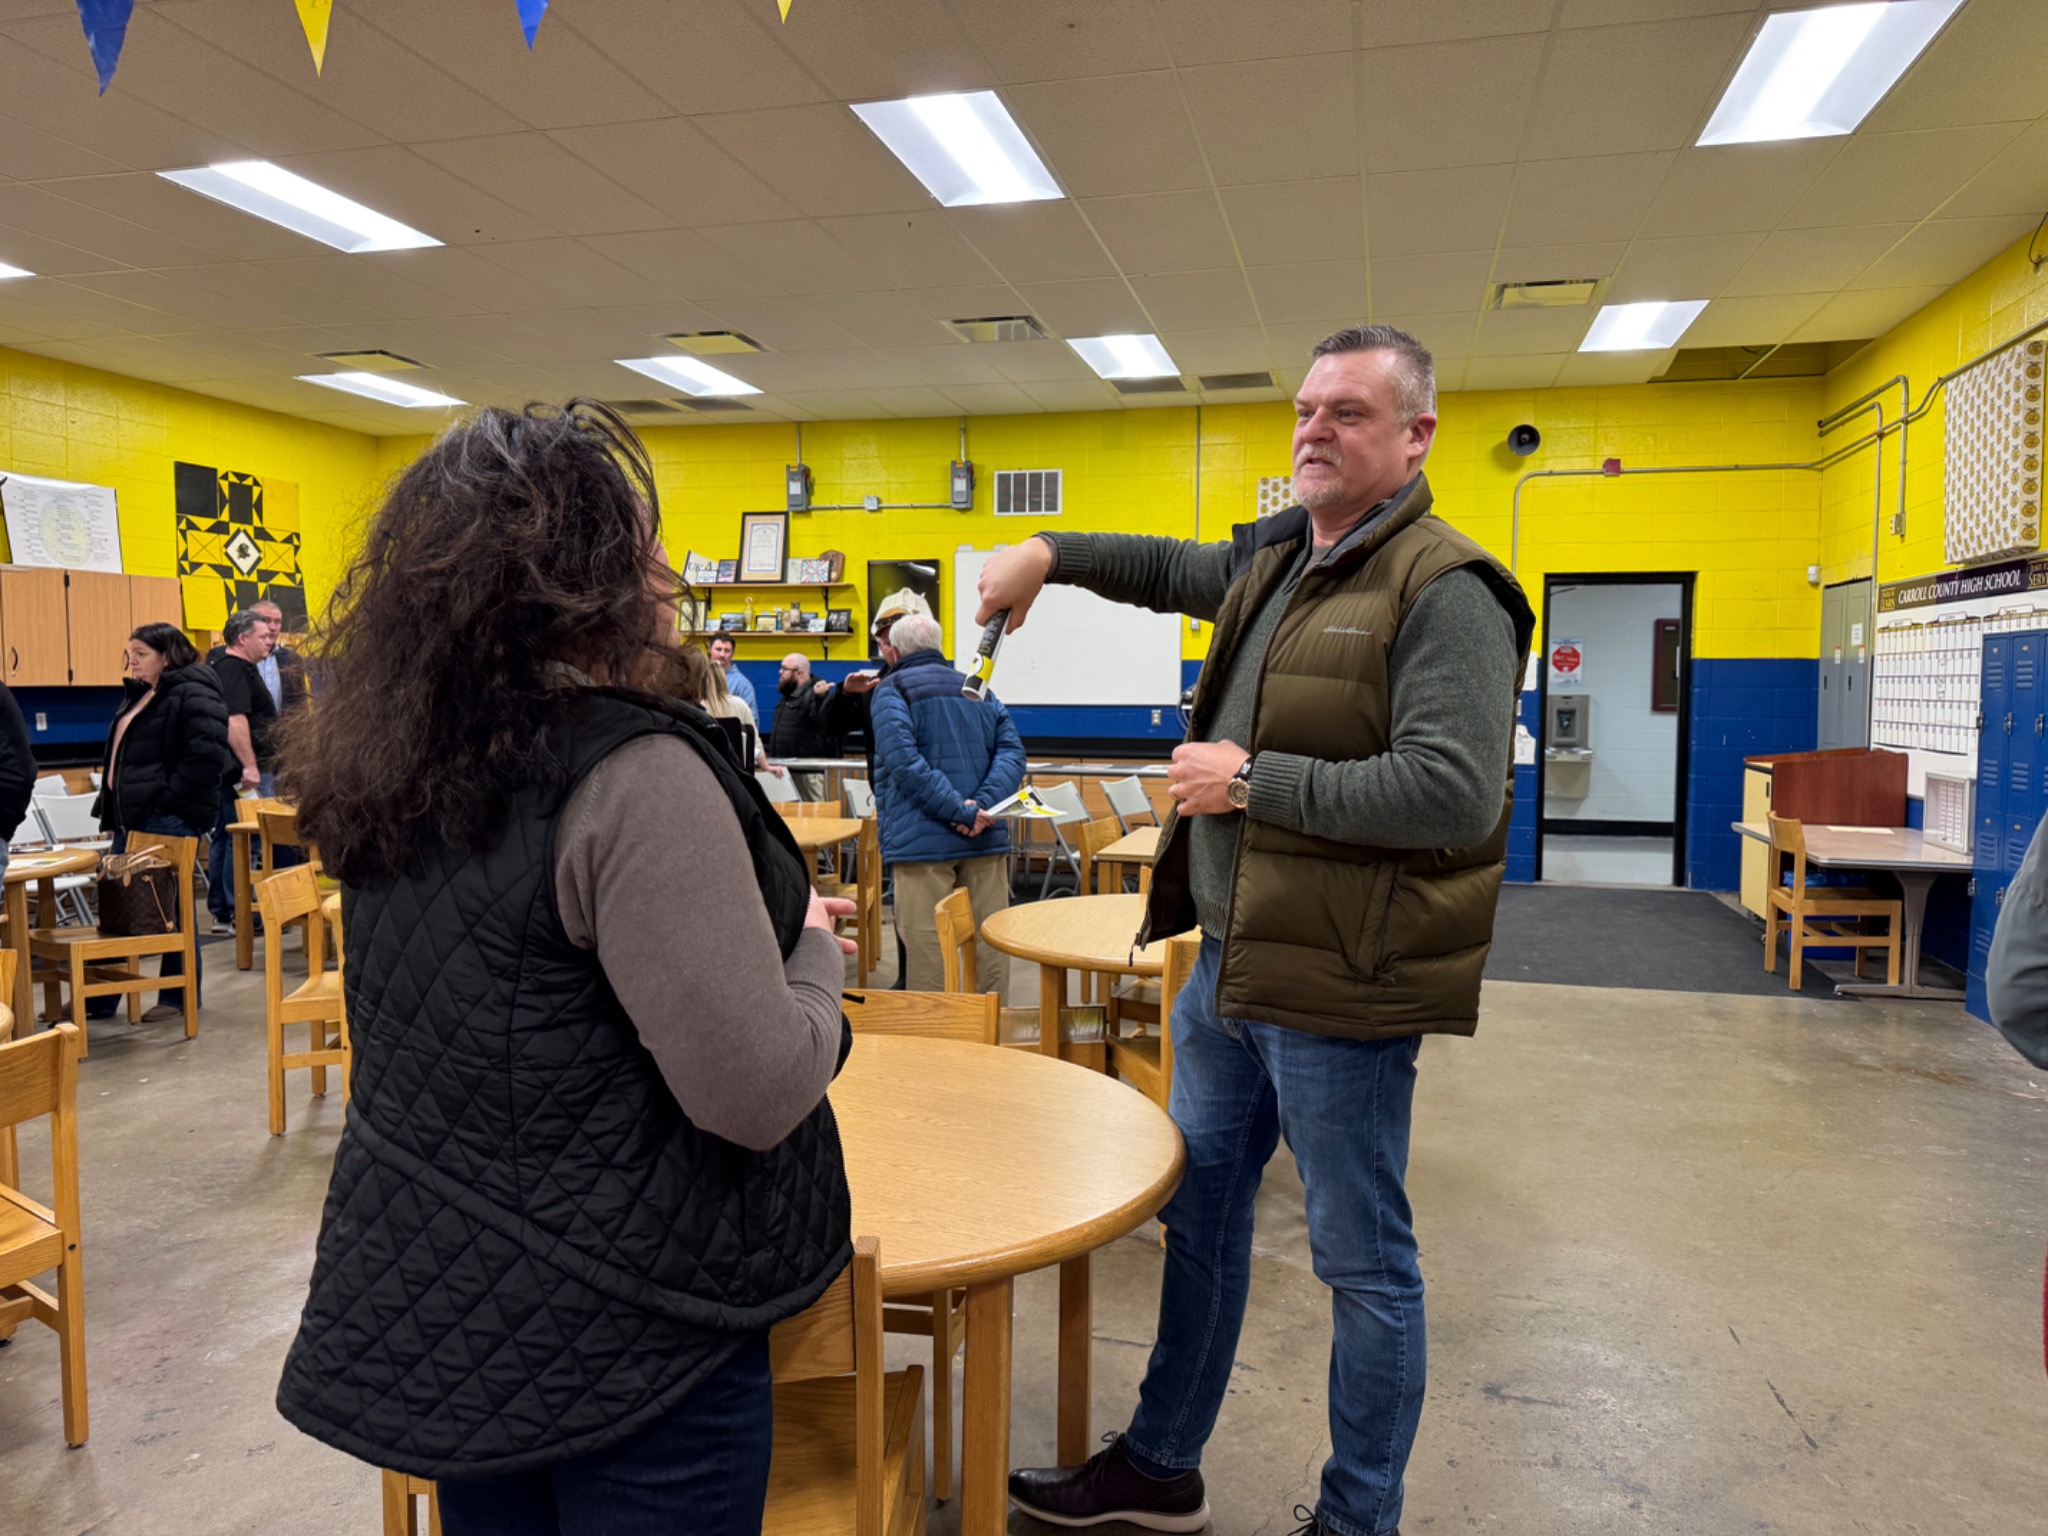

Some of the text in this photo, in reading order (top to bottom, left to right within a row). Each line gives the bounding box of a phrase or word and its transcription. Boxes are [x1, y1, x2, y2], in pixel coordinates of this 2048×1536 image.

[1898, 586, 1927, 604] CARROLL
[1928, 579, 1960, 599] COUNTY
[1960, 575, 1984, 594] HIGH
[1984, 569, 2021, 590] SCHOOL
